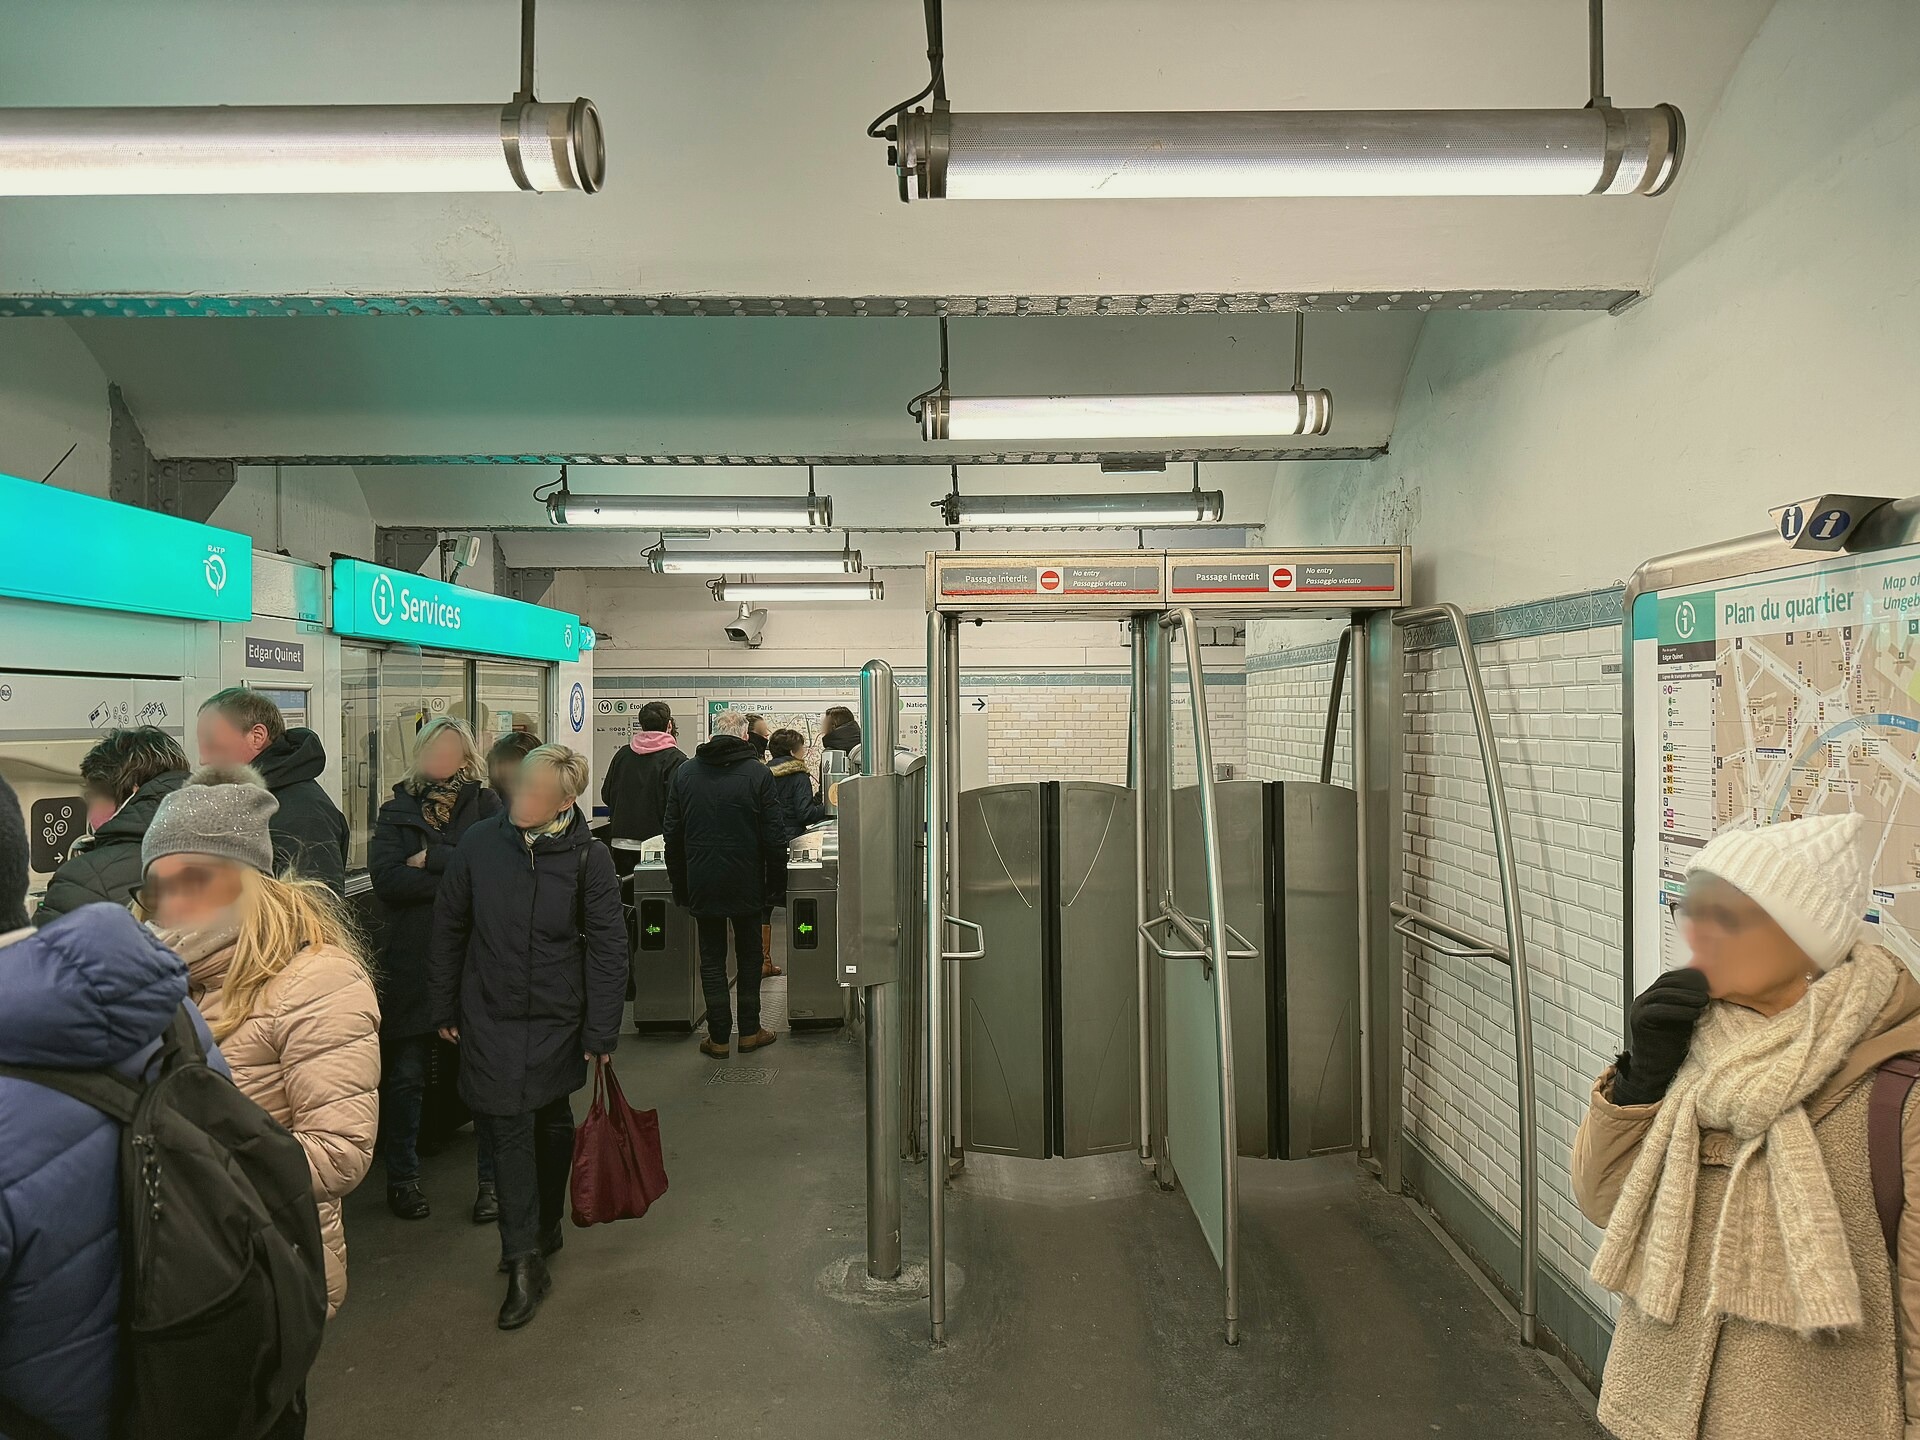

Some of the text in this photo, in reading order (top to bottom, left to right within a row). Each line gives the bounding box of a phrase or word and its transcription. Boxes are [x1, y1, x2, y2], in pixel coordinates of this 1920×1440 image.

[207, 544, 226, 554] RATP
[1083, 570, 1101, 578] entry
[1316, 567, 1334, 575] entry
[965, 575, 997, 584] Passage
[1196, 573, 1228, 583] Passage
[1305, 577, 1338, 586] Passaggio
[1882, 571, 1920, 591] Map of
[1072, 580, 1104, 588] Passaggio
[400, 588, 462, 630] Services
[1725, 602, 1755, 625] Plan
[1760, 597, 1780, 621] du
[1785, 588, 1854, 624] quartier
[248, 644, 302, 664] Edgar Quinet
[617, 703, 623, 711] 6
[629, 702, 645, 710] Étoil
